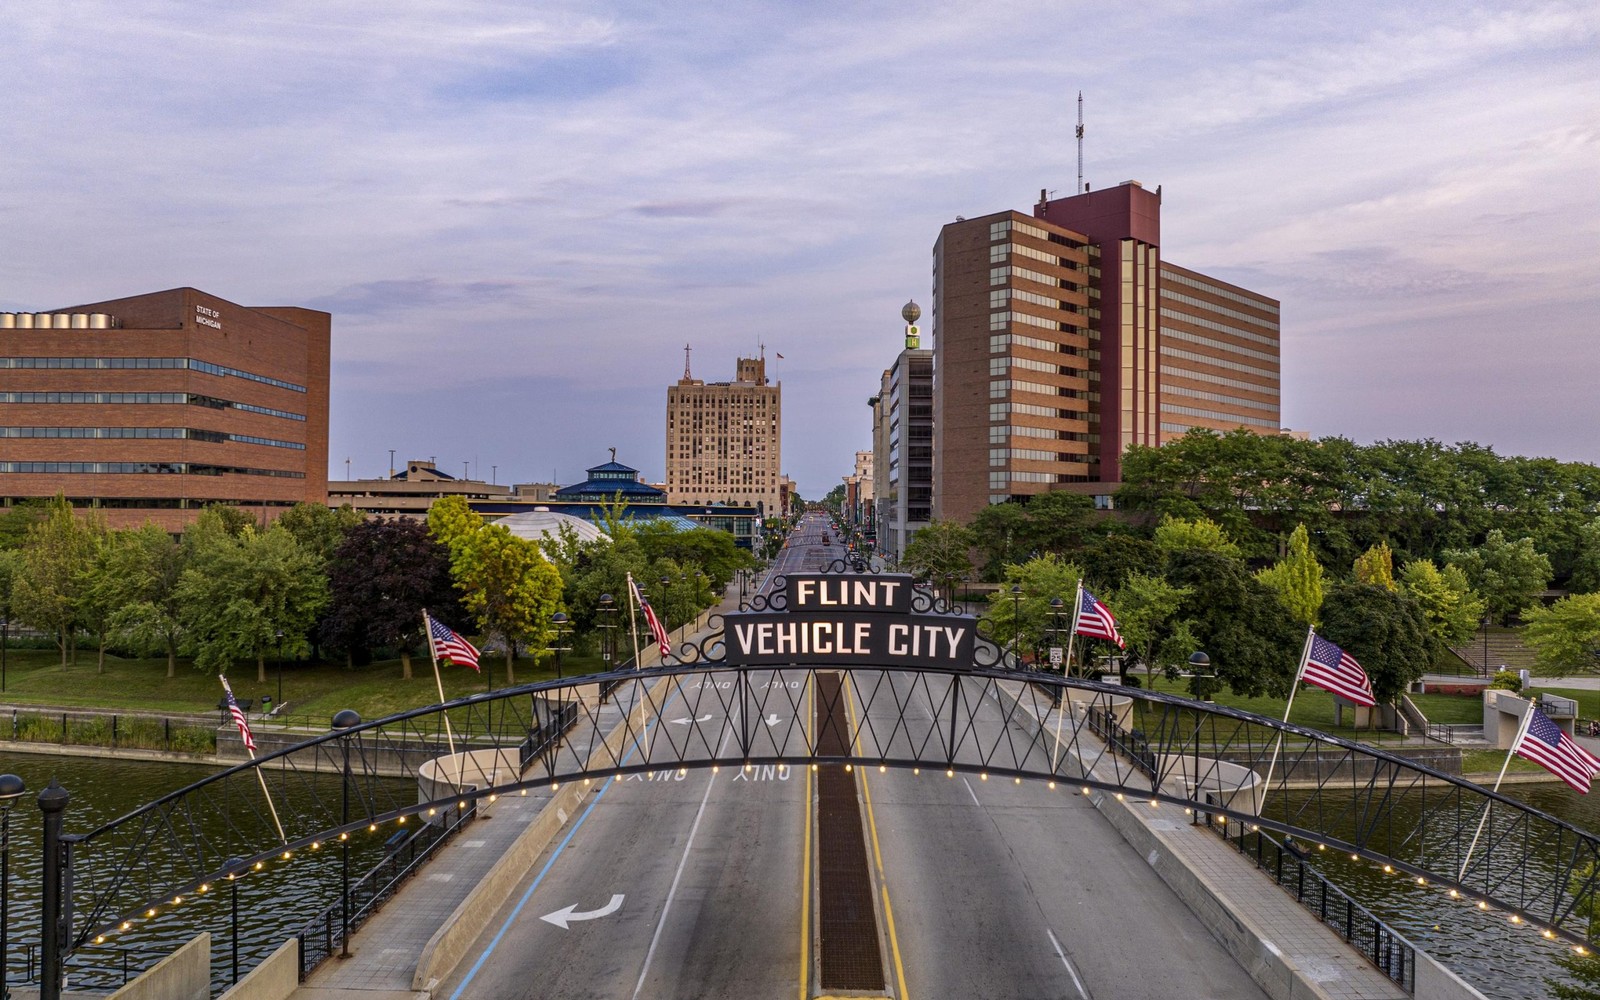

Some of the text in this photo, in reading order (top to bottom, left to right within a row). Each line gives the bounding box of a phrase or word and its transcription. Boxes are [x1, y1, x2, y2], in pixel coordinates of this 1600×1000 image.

[196, 305, 220, 318] STATE OF
[196, 315, 221, 329] MICHIGAN
[798, 580, 900, 606] FLINT
[734, 622, 966, 659] VEHICLE CITY
[689, 681, 731, 689] ONLY
[760, 681, 799, 689] ONLY
[733, 764, 791, 781] ONLY
